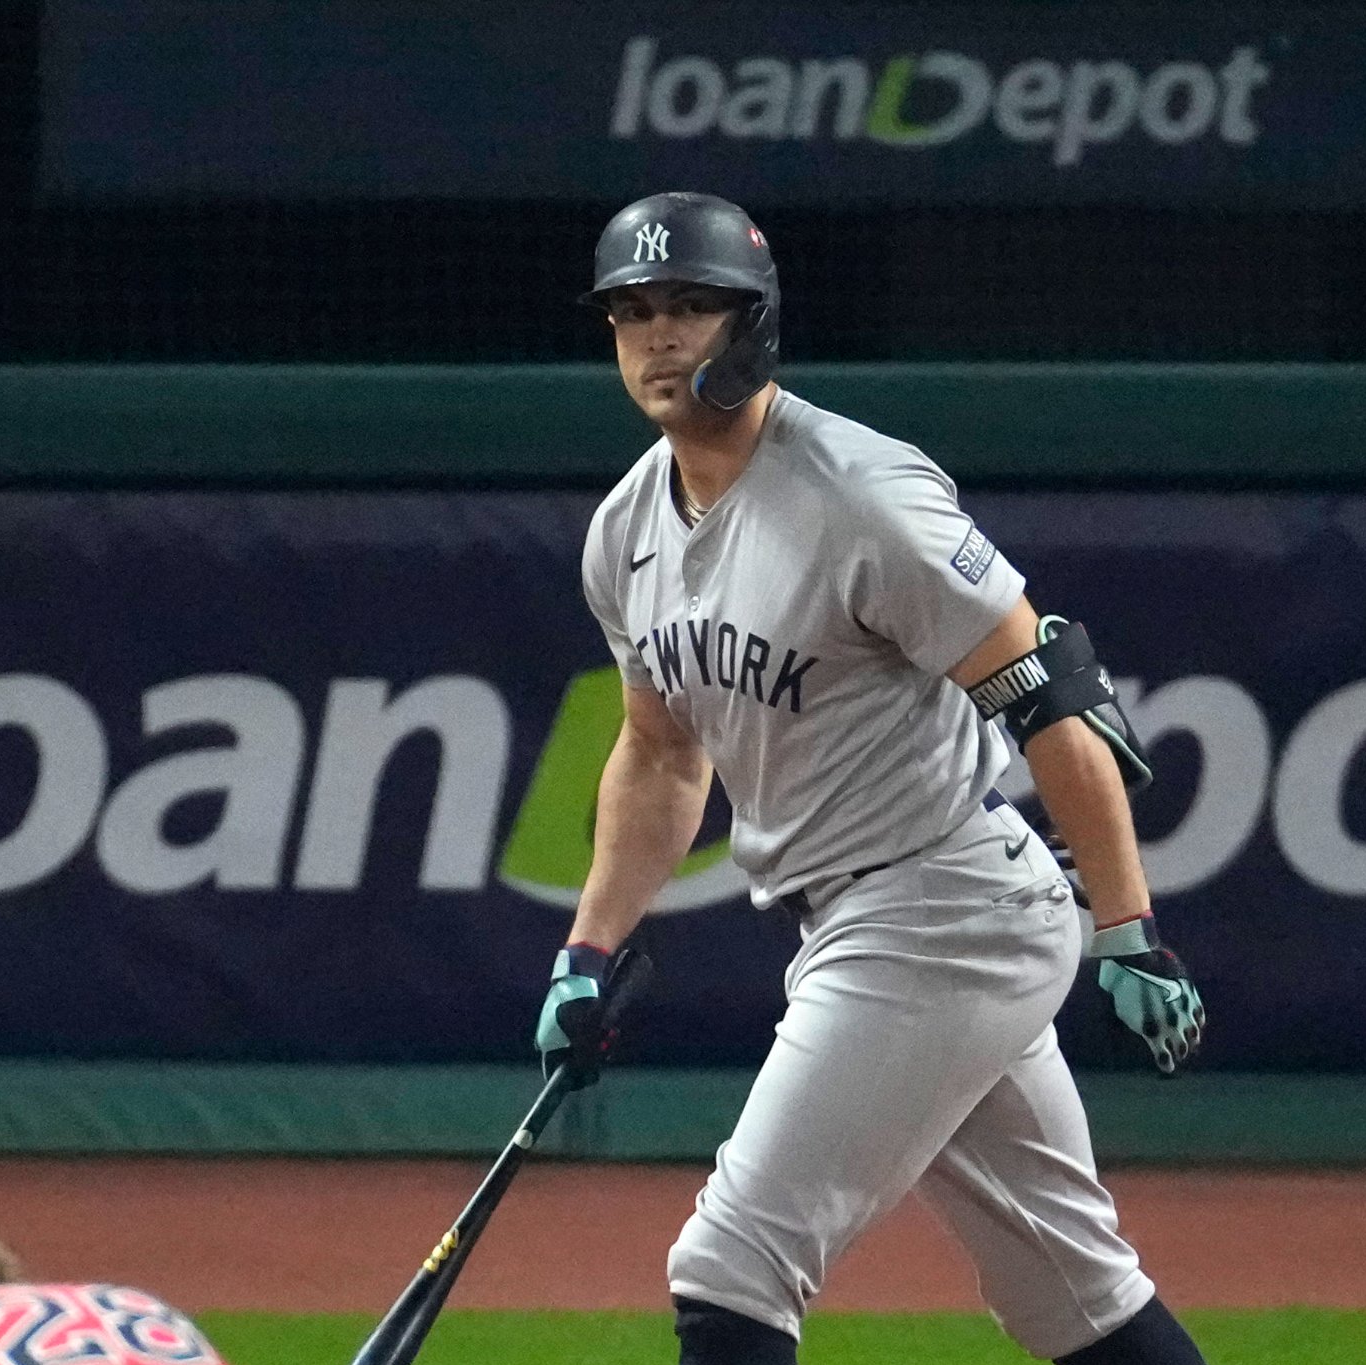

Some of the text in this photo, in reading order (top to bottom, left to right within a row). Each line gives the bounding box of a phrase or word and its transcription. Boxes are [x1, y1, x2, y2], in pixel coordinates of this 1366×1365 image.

[609, 36, 1271, 167] loanDepot
[633, 222, 671, 263] NY
[687, 618, 820, 714] YORK
[969, 653, 1050, 717] STANTON
